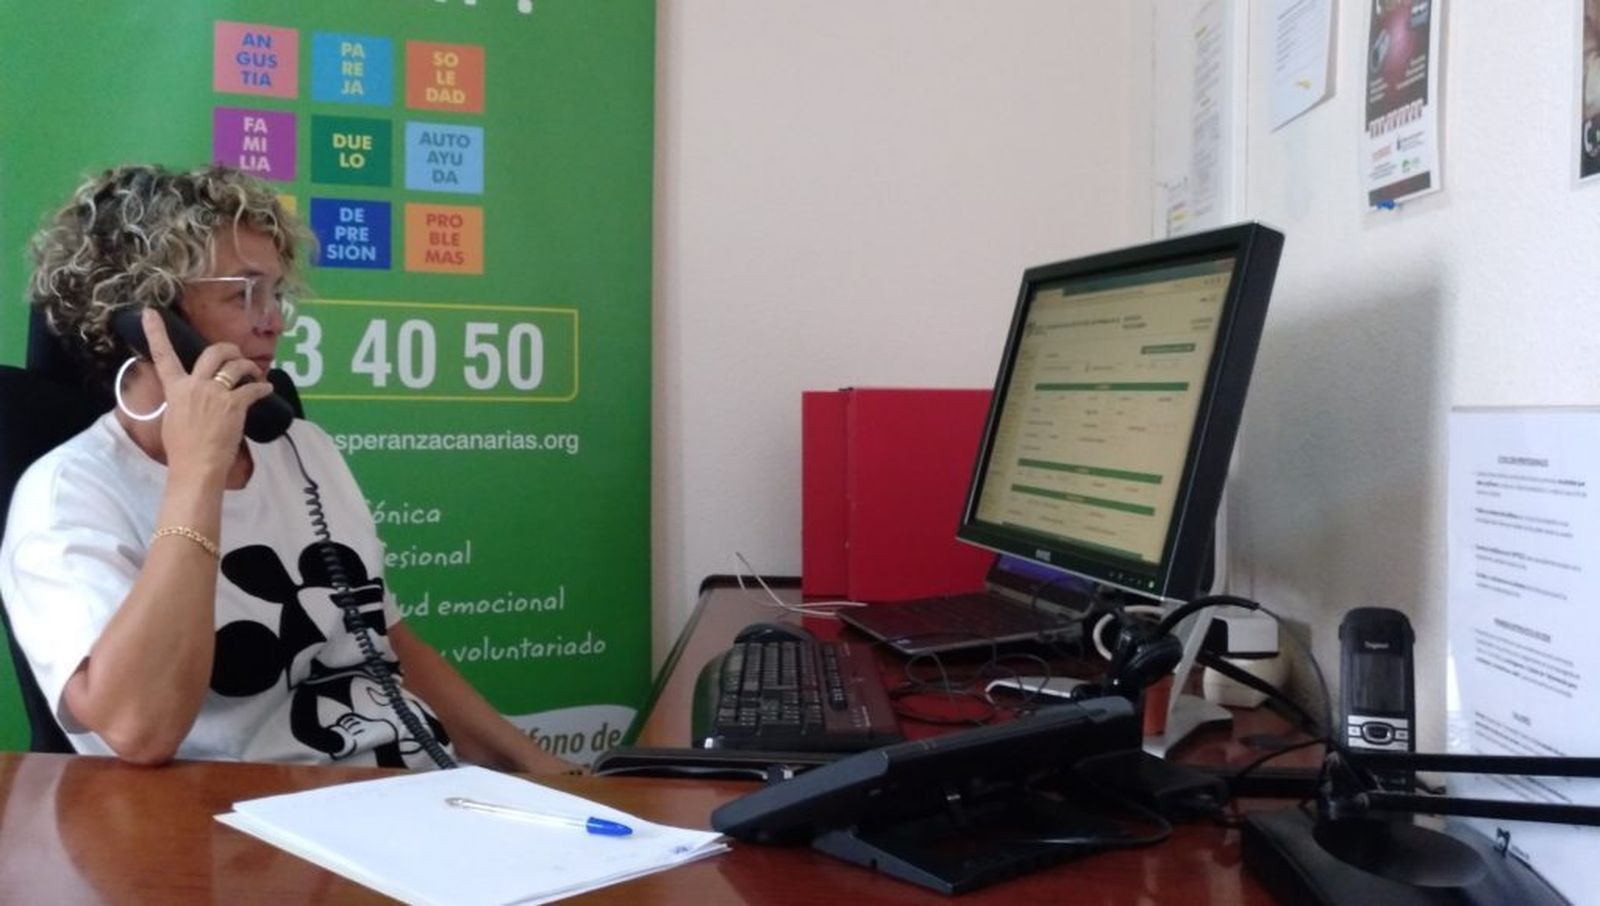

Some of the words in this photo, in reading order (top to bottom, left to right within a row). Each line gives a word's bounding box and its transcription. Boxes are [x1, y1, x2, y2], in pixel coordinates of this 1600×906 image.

[242, 33, 272, 49] AN
[341, 42, 366, 58] PA
[236, 51, 278, 68] GUS
[433, 51, 459, 68] SO
[342, 61, 364, 77] RE
[241, 70, 272, 87] TIA
[436, 71, 456, 86] LE
[340, 80, 364, 96] JA
[425, 87, 466, 105] DAD
[244, 117, 268, 135] FA
[243, 137, 267, 153] MI
[333, 133, 373, 151] DUE
[419, 131, 471, 148] AUTO
[240, 155, 271, 173] LIA
[340, 152, 365, 169] LO
[426, 150, 463, 167] AYU
[432, 169, 459, 184] DA
[340, 208, 364, 224] DE
[426, 213, 463, 229] PRO
[335, 226, 369, 243] PRE
[429, 231, 461, 247] BLE
[326, 241, 377, 262] SIÓN
[425, 249, 465, 265] MAS
[270, 315, 323, 387] 3
[351, 319, 437, 389] 40
[463, 322, 545, 390] 50
[334, 431, 579, 454] speranzacanarias.org
[367, 500, 441, 525] ónica
[382, 540, 471, 568] esional
[438, 586, 565, 616] emocional
[452, 631, 606, 662] voluntariado
[591, 722, 621, 752] de
